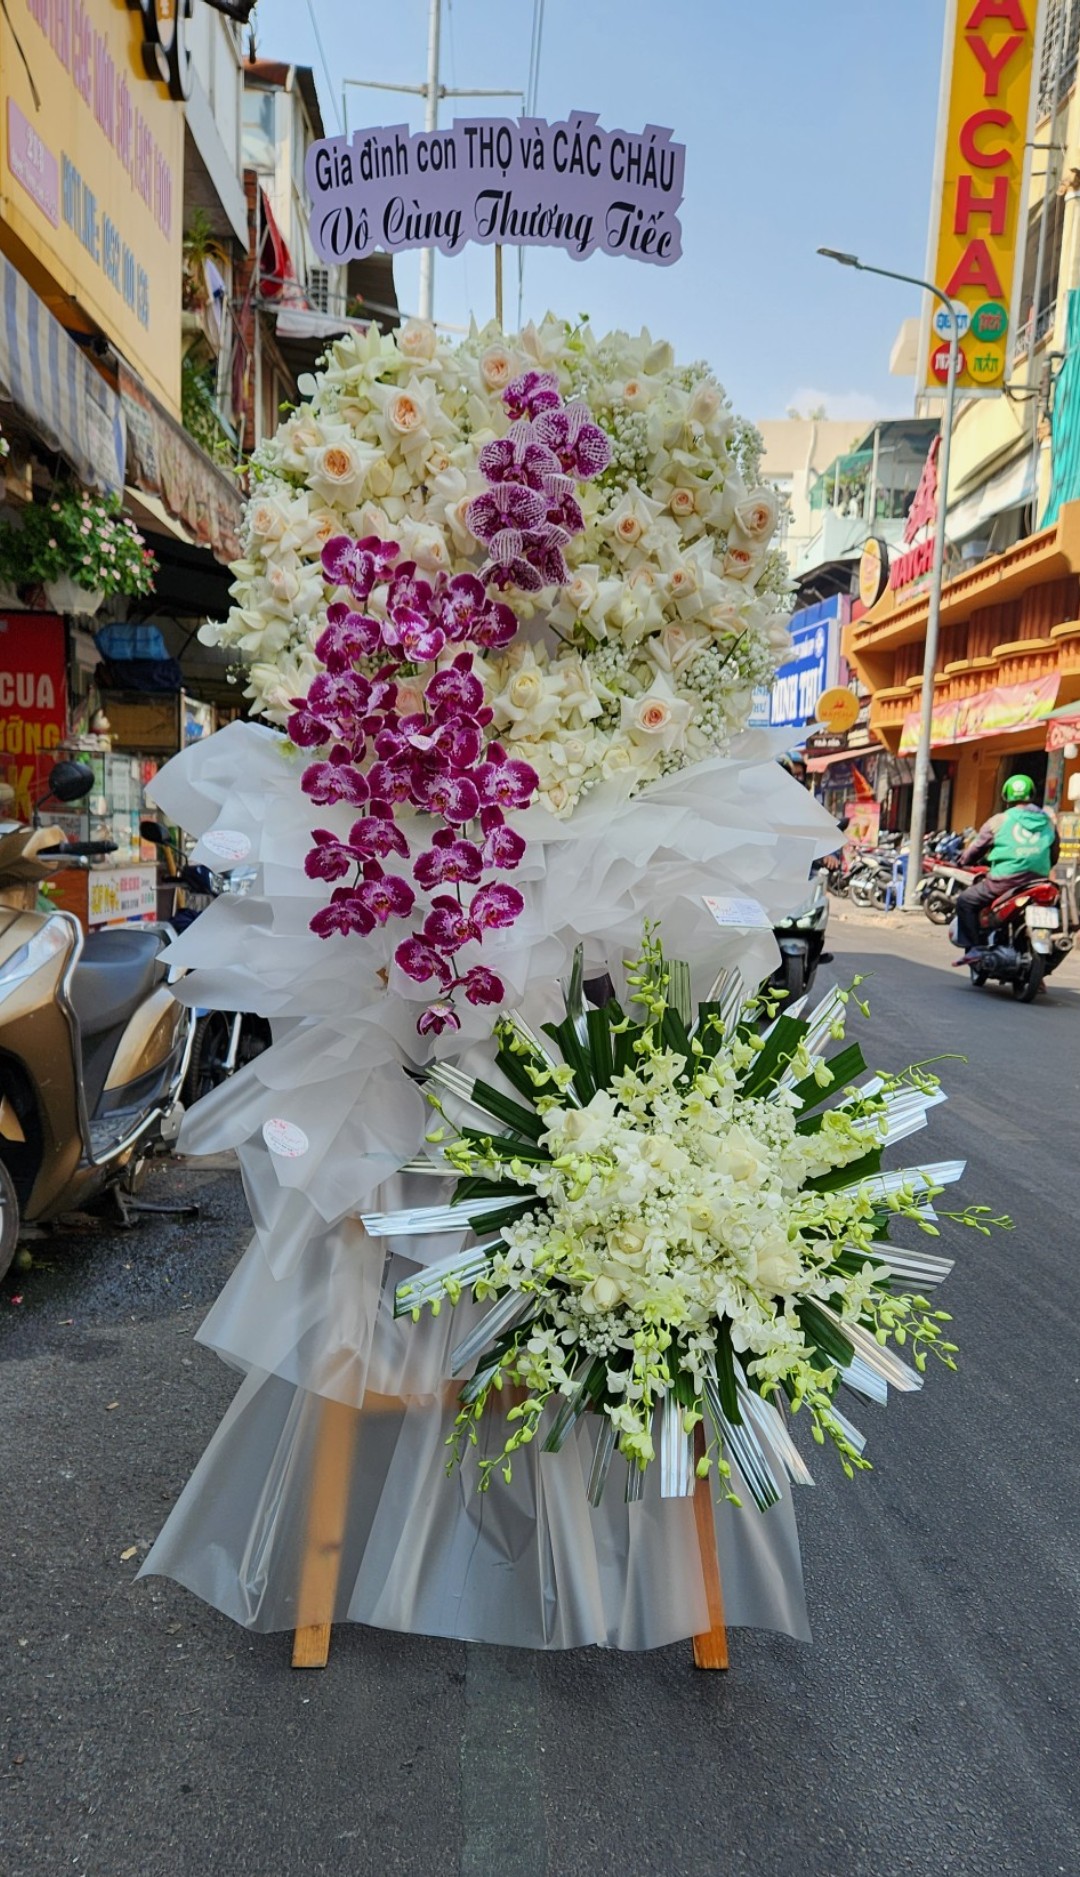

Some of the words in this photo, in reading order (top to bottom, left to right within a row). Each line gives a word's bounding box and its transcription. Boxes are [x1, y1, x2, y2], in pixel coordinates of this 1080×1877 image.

[315, 148, 352, 191] Gia
[360, 135, 408, 181] đình
[417, 136, 456, 172] con
[464, 126, 512, 178] THỌ
[520, 127, 544, 171] và
[553, 121, 601, 177] CÁC
[610, 134, 675, 191] CHÁU
[320, 206, 373, 256] Vô
[383, 196, 465, 250] Cùng
[474, 189, 594, 253] Thương
[605, 201, 672, 259] Tiếc
[889, 535, 936, 592] MAYCH
